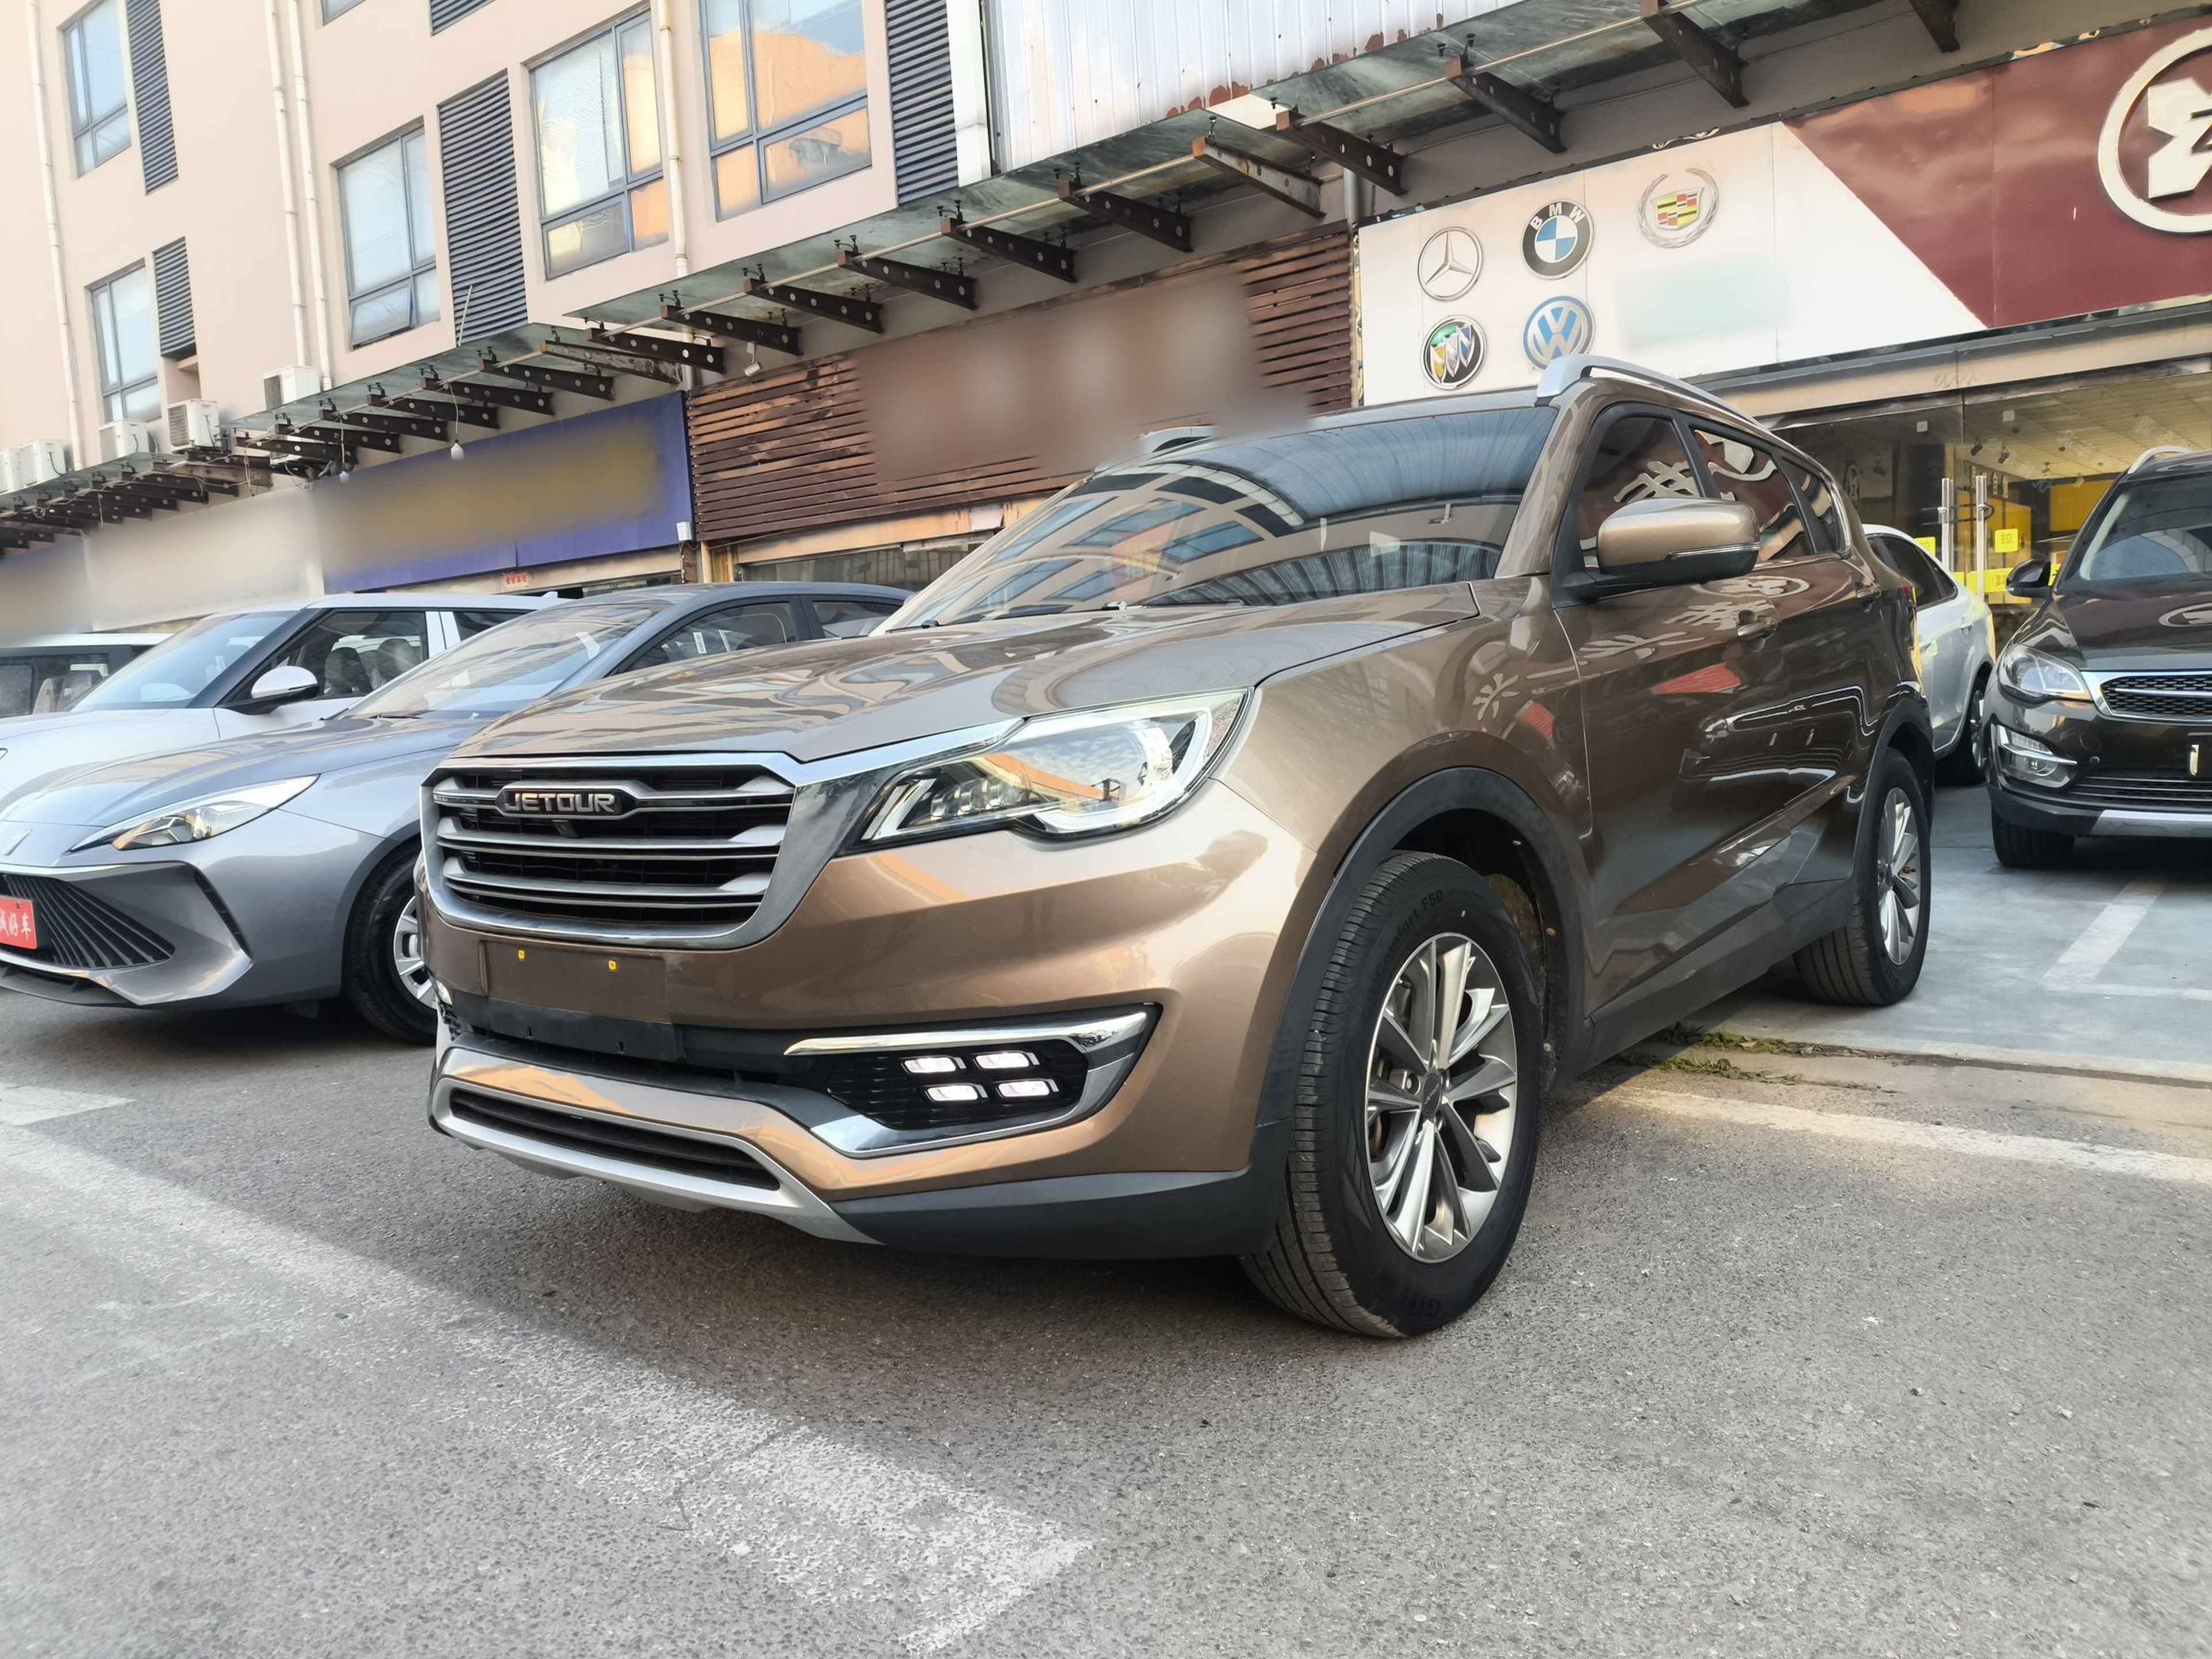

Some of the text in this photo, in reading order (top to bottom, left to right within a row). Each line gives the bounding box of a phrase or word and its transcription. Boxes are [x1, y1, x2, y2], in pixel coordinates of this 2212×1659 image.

[1529, 202, 1585, 230] BMW
[505, 793, 615, 813] JETOUR
[1421, 889, 1444, 911] F50
